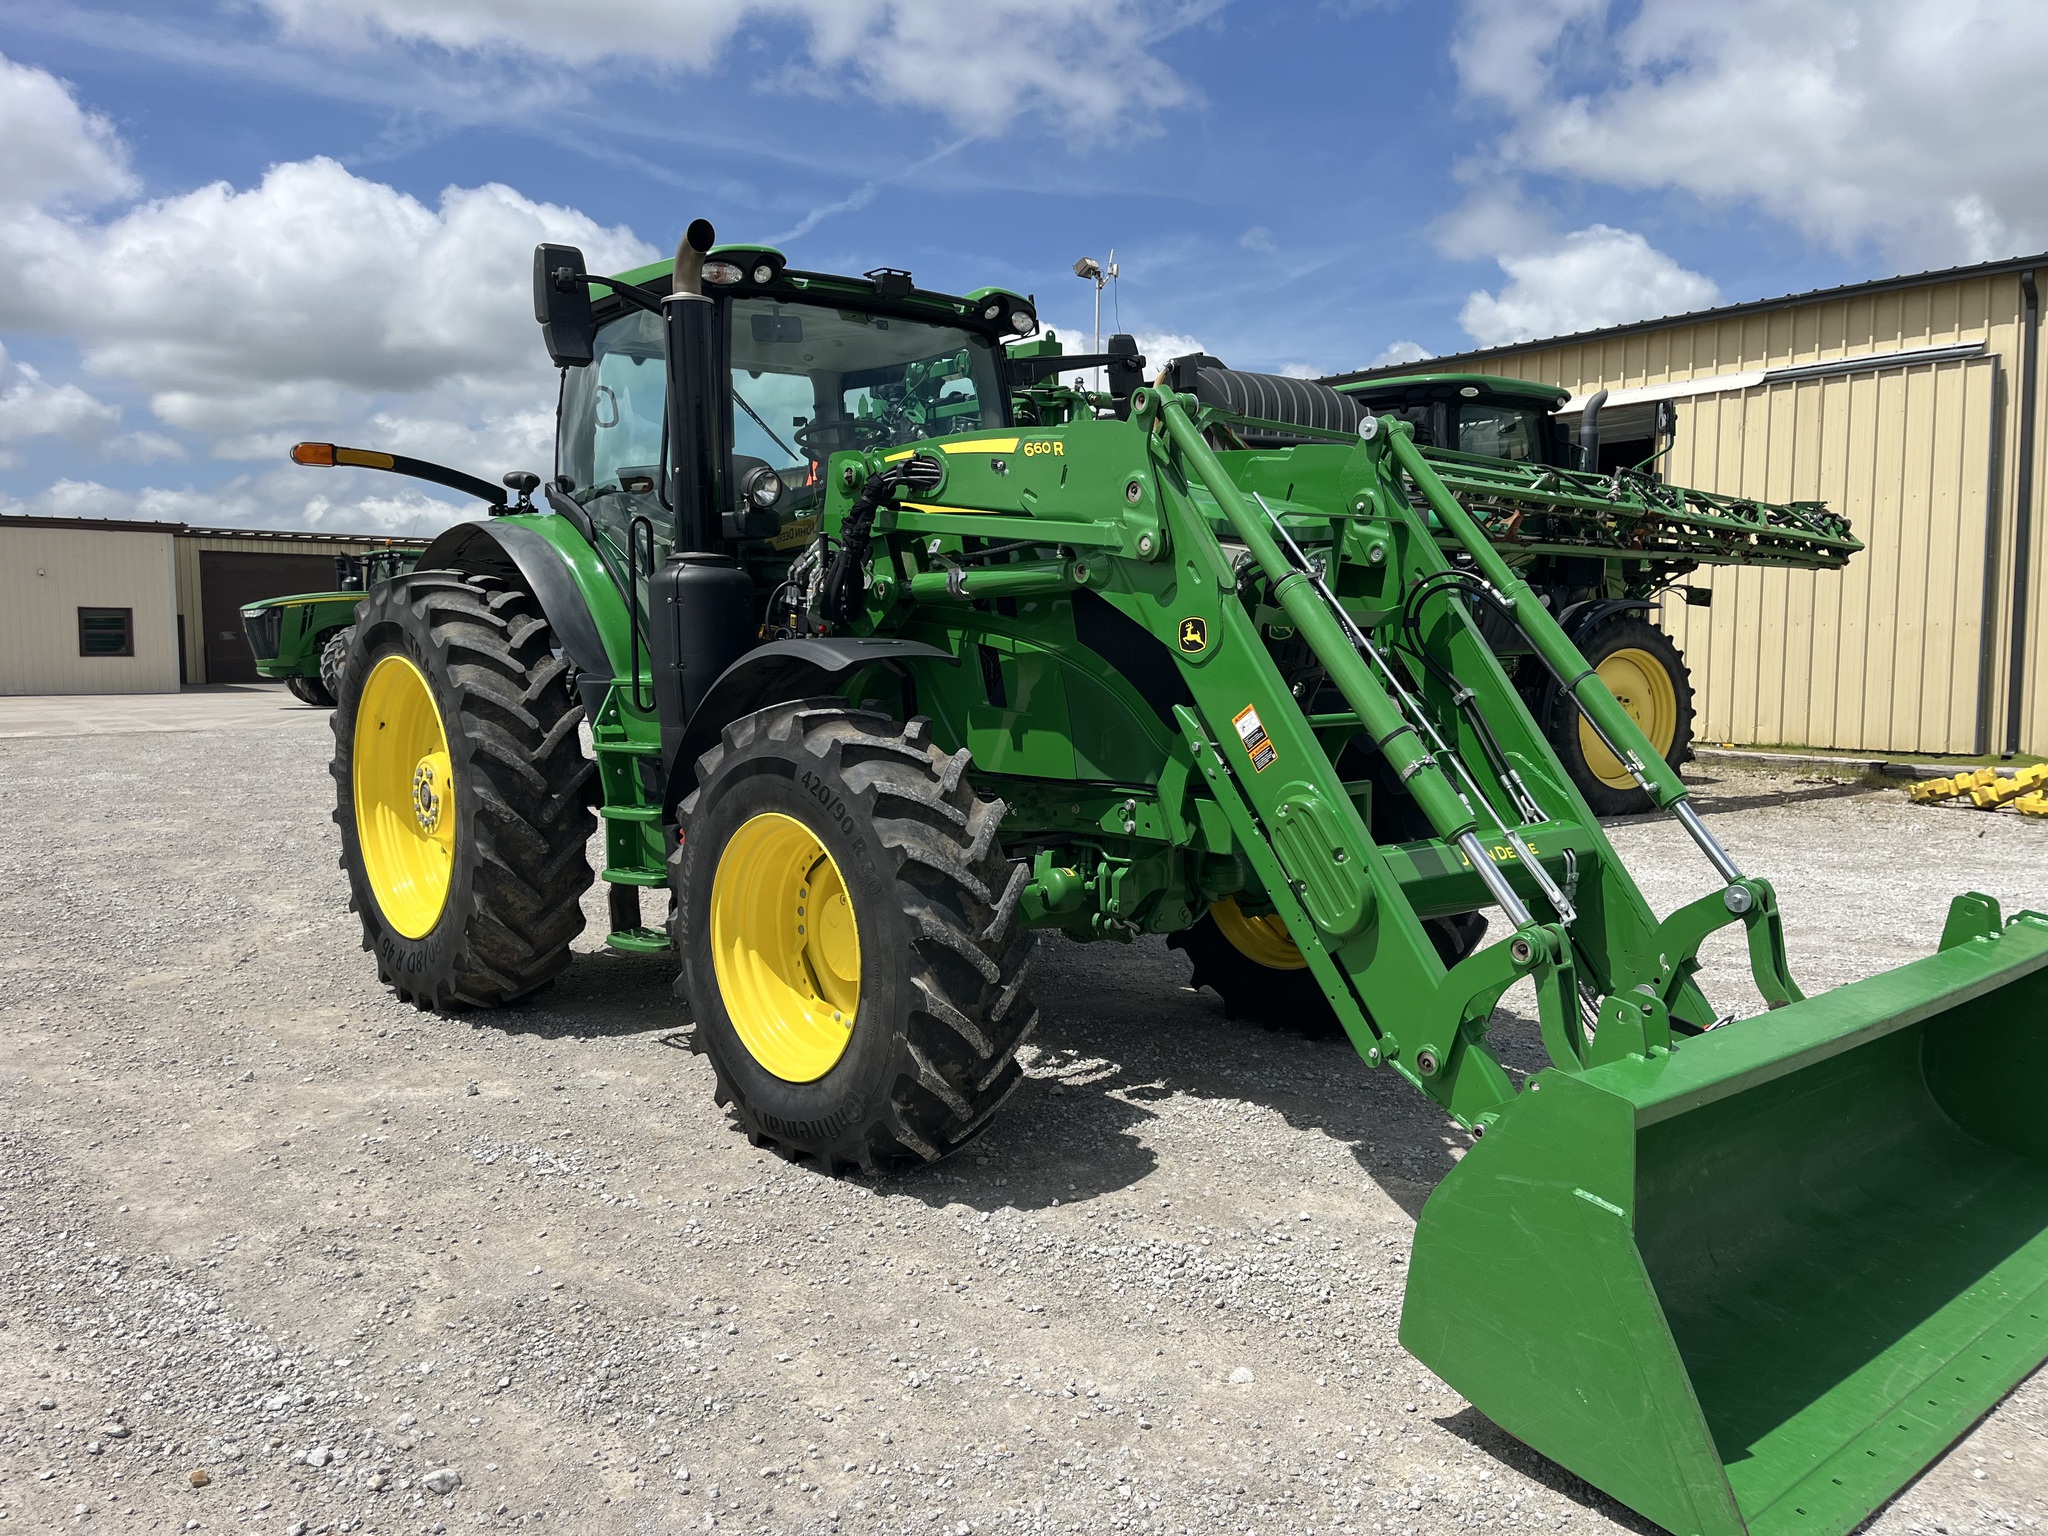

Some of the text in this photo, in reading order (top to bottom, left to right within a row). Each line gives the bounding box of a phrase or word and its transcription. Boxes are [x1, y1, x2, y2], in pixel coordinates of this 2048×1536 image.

[1023, 441, 1051, 457] 660
[801, 770, 854, 835] 420/90
[851, 835, 867, 857] R
[861, 860, 882, 897] 30
[765, 1091, 866, 1140] Continental
